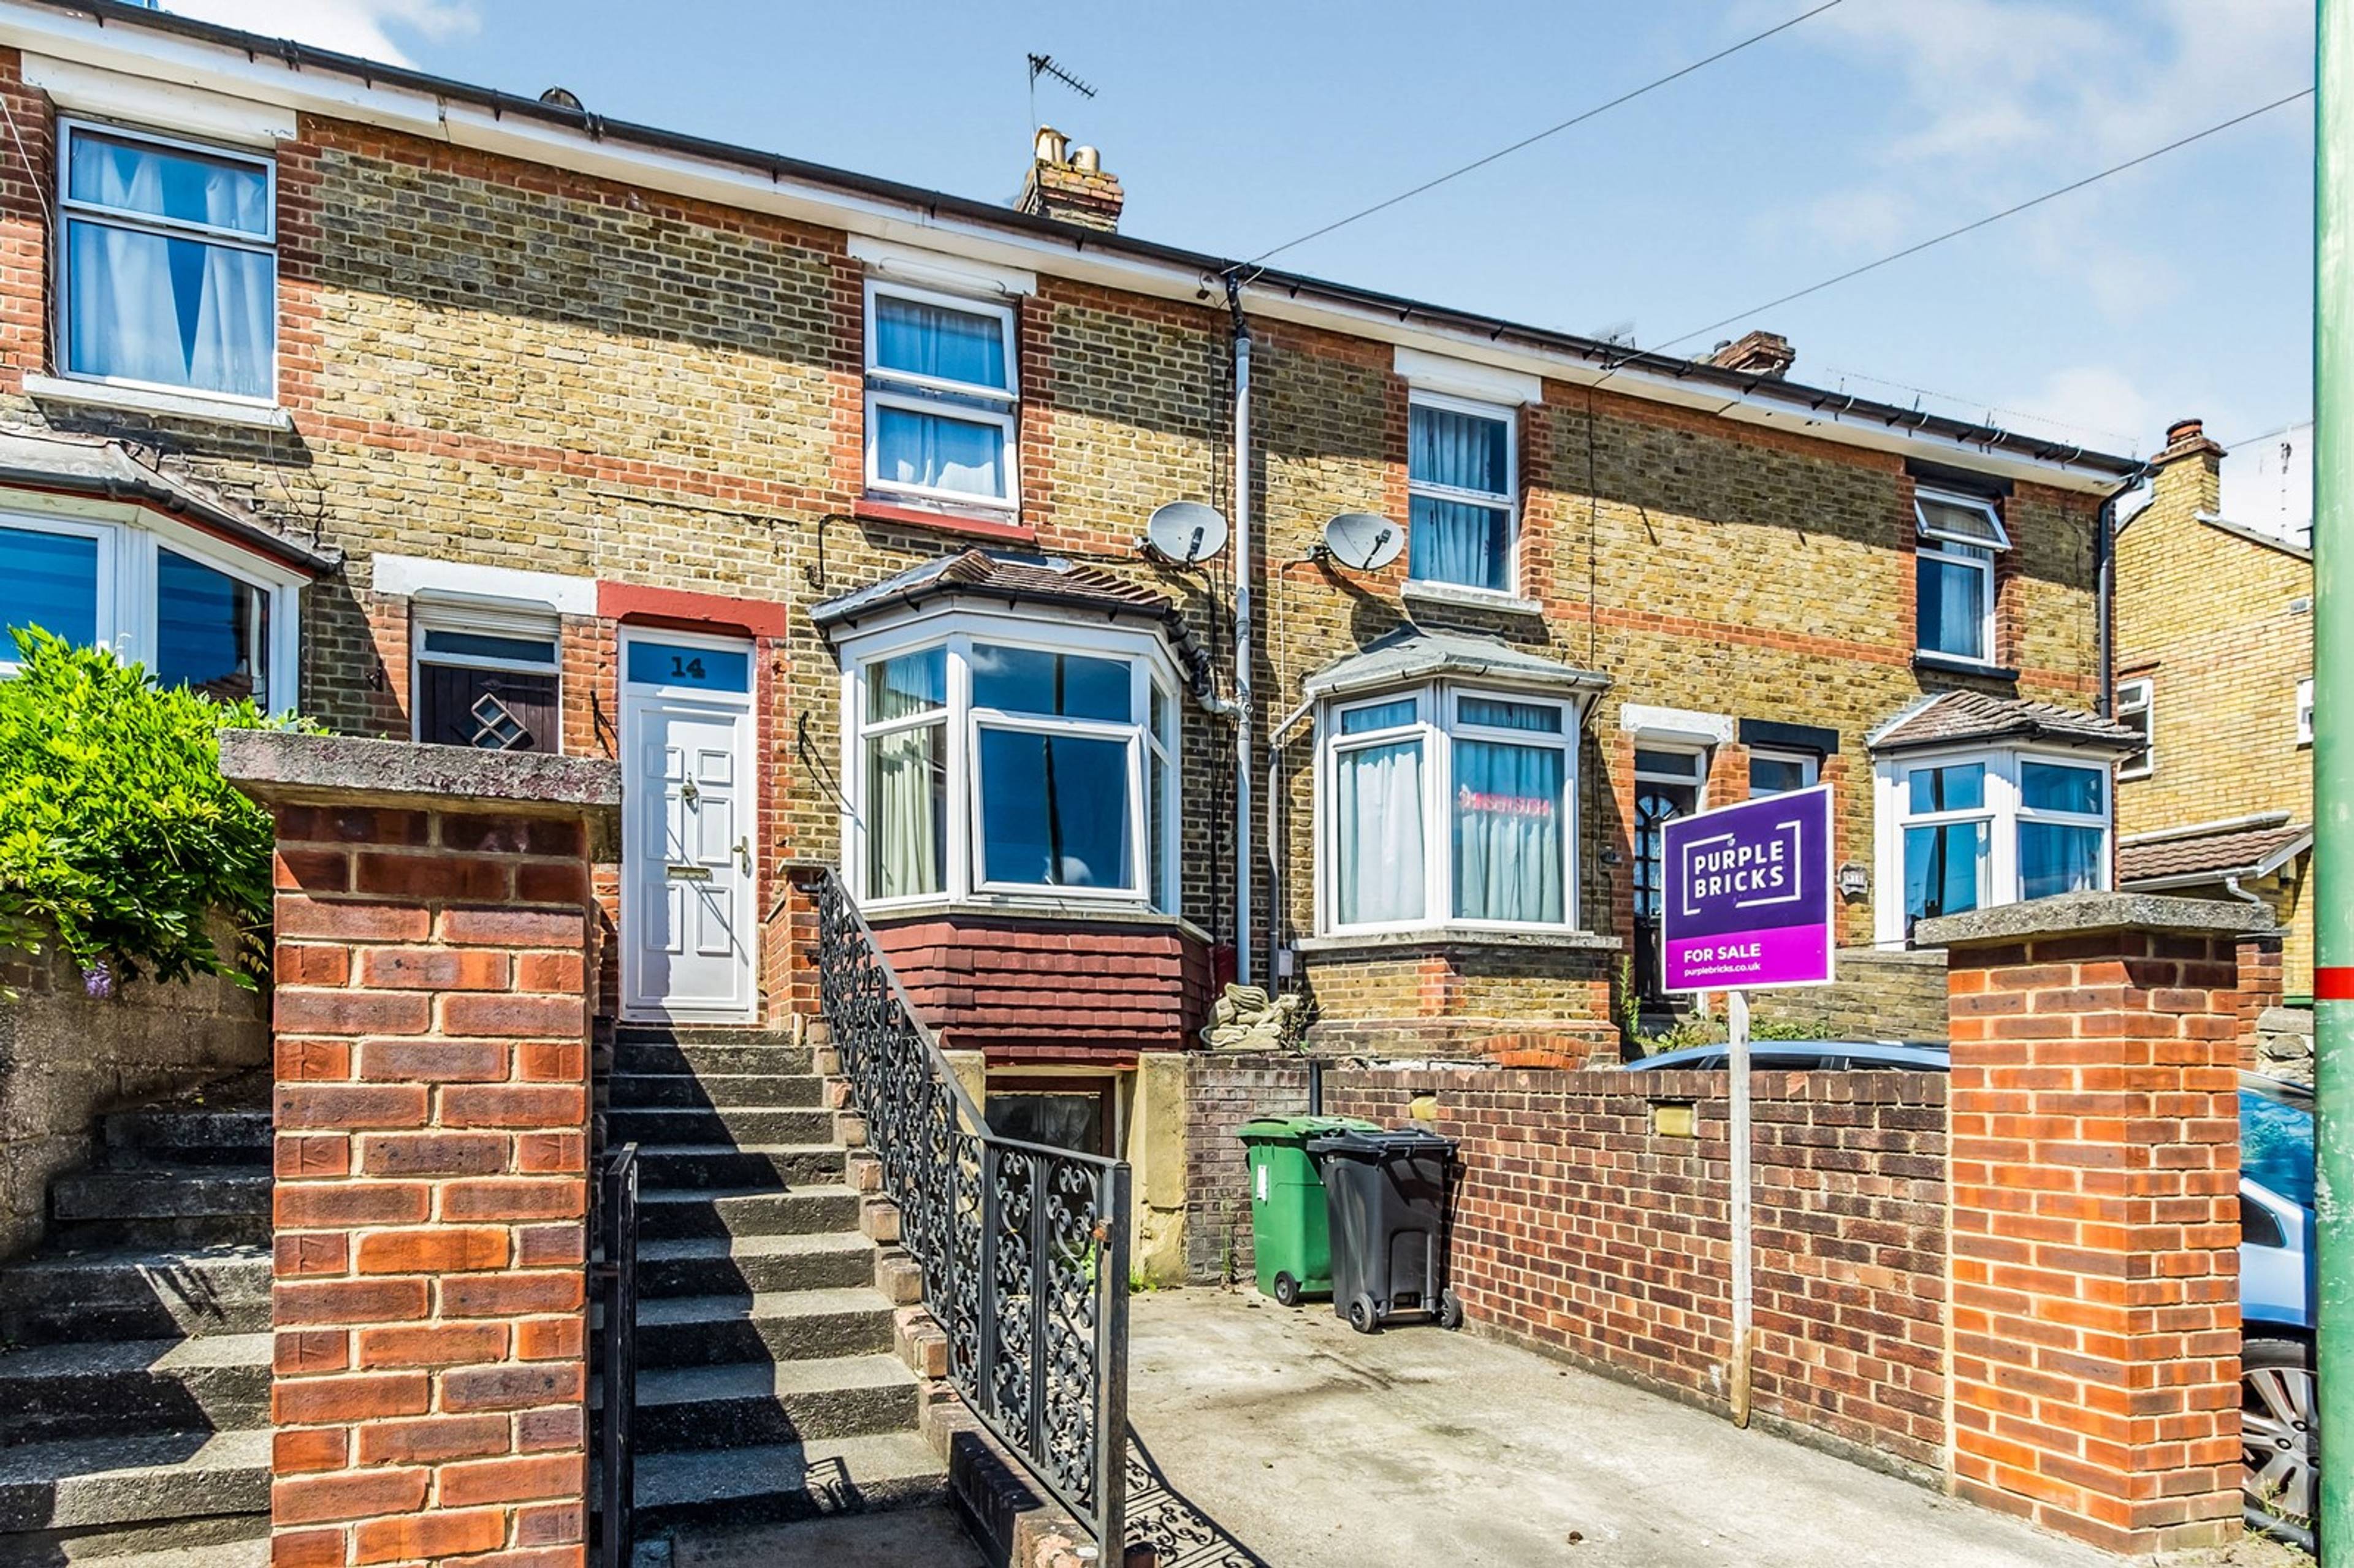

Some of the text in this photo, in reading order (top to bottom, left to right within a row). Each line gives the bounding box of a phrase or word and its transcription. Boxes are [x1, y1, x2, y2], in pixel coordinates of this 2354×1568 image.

[671, 656, 706, 679] 14
[1694, 840, 1784, 875] PURPLE
[1694, 865, 1784, 899] BRICKS
[1684, 943, 1762, 963] FOR SALE
[1684, 962, 1761, 977] purplebricks.co.uk
